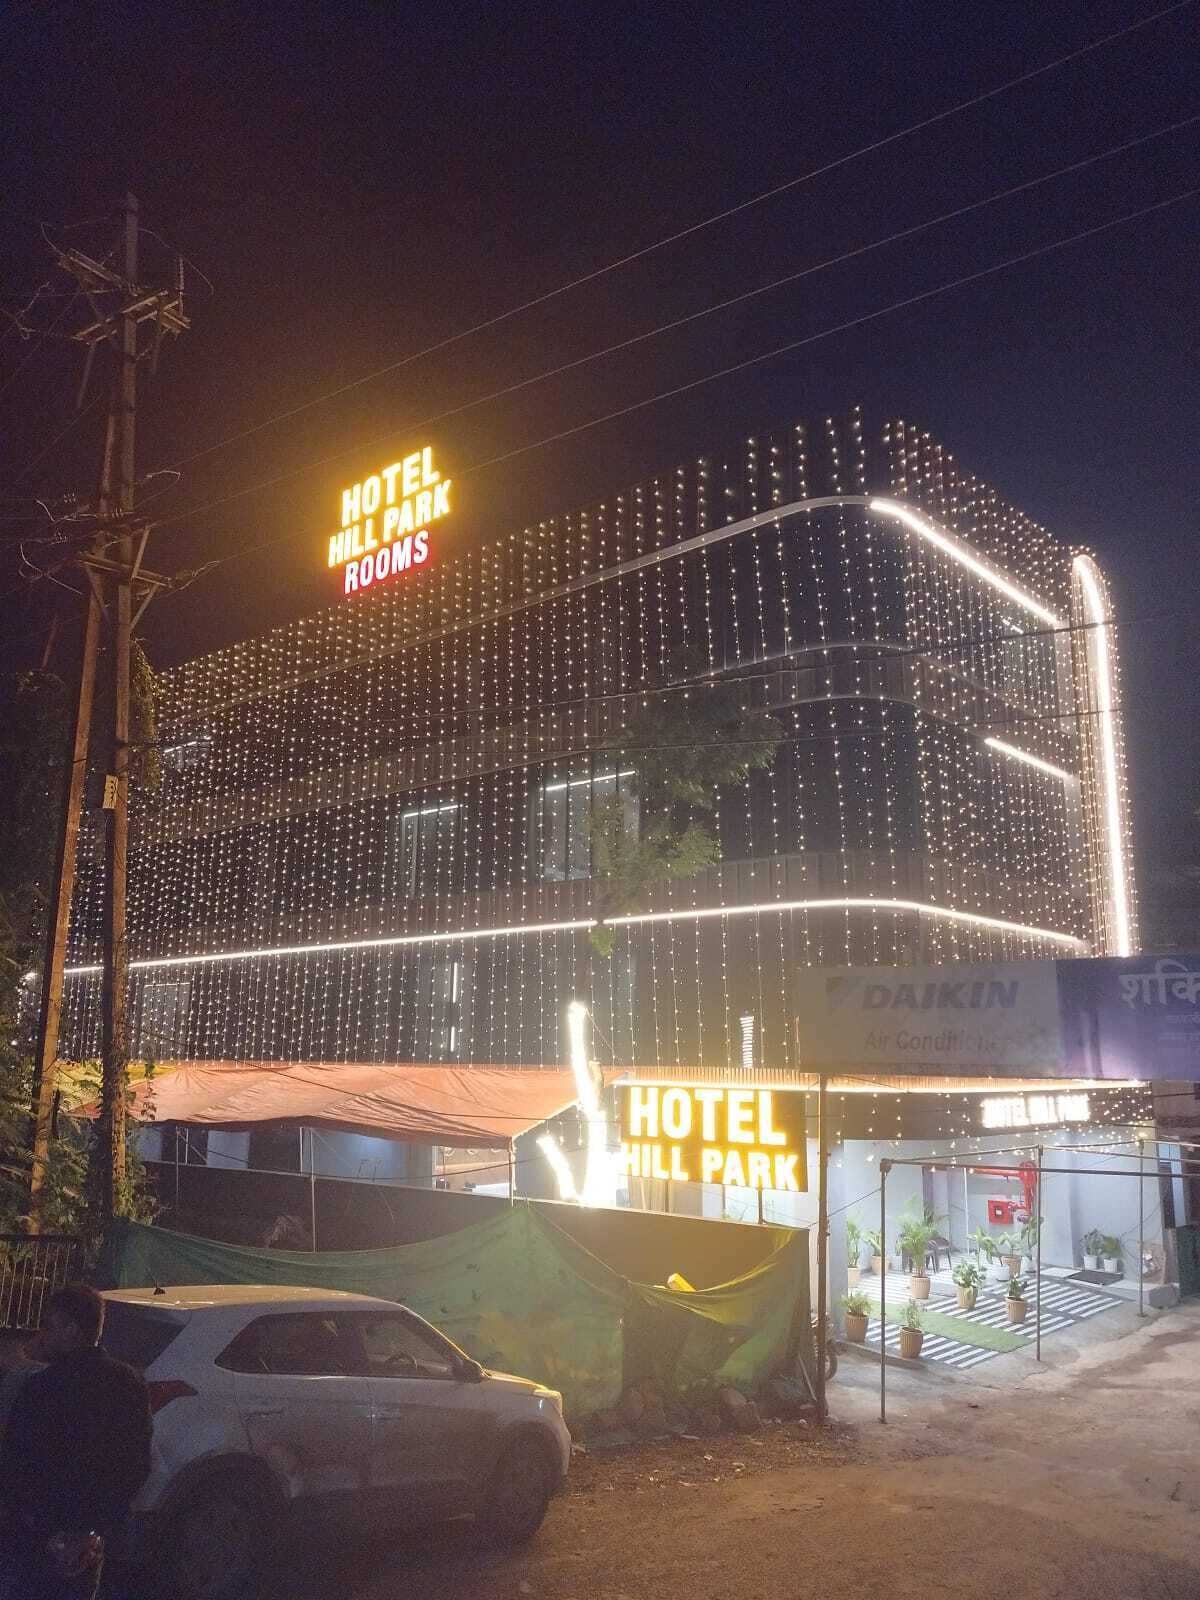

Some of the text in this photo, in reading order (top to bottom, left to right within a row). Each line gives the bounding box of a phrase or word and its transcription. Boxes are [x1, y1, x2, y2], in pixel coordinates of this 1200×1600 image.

[342, 446, 440, 528] HOTEL
[328, 479, 451, 567] HILL PARK
[345, 530, 429, 594] ROOMS
[862, 980, 1018, 1009] DAIKIN
[864, 1031, 890, 1050] Air
[630, 1086, 787, 1145] HOTEL
[621, 1142, 799, 1192] HILL PARK
